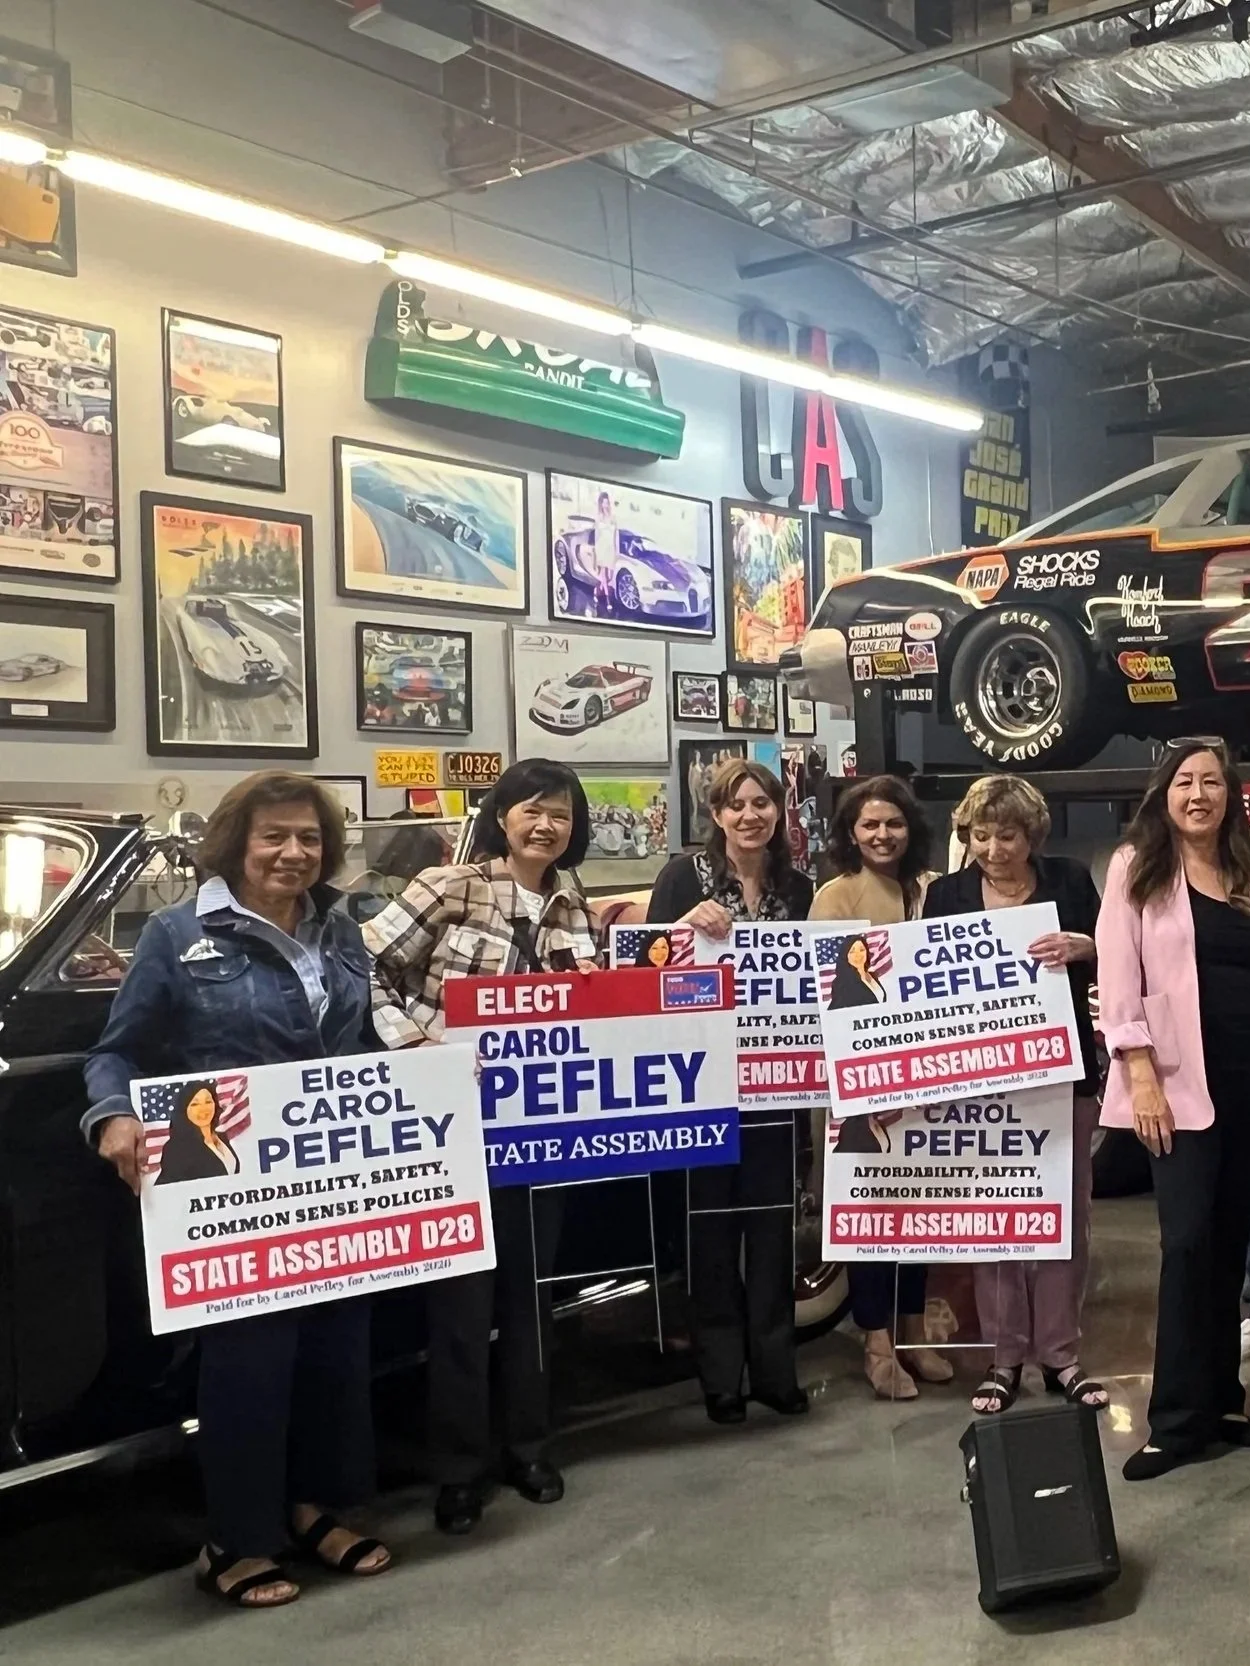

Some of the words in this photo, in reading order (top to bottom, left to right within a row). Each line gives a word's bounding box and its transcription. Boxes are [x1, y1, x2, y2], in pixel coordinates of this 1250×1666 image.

[523, 363, 585, 389] BANDIT
[10, 424, 40, 439] 100
[1017, 550, 1100, 575] SHOCKS
[967, 567, 1001, 589] NAPA
[1014, 574, 1058, 591] Regal
[1060, 572, 1095, 586] Ride
[849, 623, 903, 639] CRAFTSMAN
[1000, 612, 1051, 632] EAGLE
[956, 701, 1063, 762] GOODYEAR
[380, 773, 435, 783] STUPID
[734, 928, 803, 949] Elect
[926, 918, 992, 944] Elect
[914, 938, 1013, 968] CAROL
[899, 958, 1043, 1003] PEFLEY
[476, 983, 573, 1016] ELECT
[852, 1003, 981, 1031] AFFORDABILITY,
[982, 994, 1042, 1013] SAFETY,
[478, 1026, 590, 1061] CAROL
[852, 1030, 925, 1051] COMMON
[929, 1022, 976, 1040] SENSE
[978, 1012, 1047, 1032] POLICIES
[300, 1061, 392, 1094] Elect
[841, 1059, 904, 1091] STATE
[910, 1042, 1017, 1081] ASSEMBLY
[1023, 1035, 1066, 1063] D28
[480, 1051, 707, 1121] PEFLEY
[281, 1088, 416, 1127] CAROL
[923, 1104, 1022, 1124] CAROL
[257, 1113, 456, 1174] PEFLEY
[485, 1138, 562, 1167] TATE
[568, 1123, 729, 1159] ASSEMBLY
[904, 1129, 1051, 1157] PEFLEY
[189, 1174, 367, 1214] AFFORDABILITY,
[370, 1161, 449, 1185] SAFETY,
[853, 1166, 979, 1180] AFFORDABILITY,
[982, 1166, 1041, 1180] SAFETY,
[850, 1187, 921, 1199] COMMON
[924, 1187, 971, 1198] SENSE
[975, 1187, 1044, 1198] POLICIES
[187, 1211, 291, 1241] COMMON
[295, 1200, 360, 1223] SENSE
[363, 1185, 455, 1212] POLICIES
[835, 1212, 895, 1237] STATE
[900, 1211, 1009, 1237] ASSEMBLY
[1014, 1211, 1056, 1236] D28
[170, 1251, 257, 1296] STATE
[267, 1225, 412, 1279] ASSEMBLY
[420, 1213, 477, 1251] D28
[206, 1301, 233, 1314] Paid
